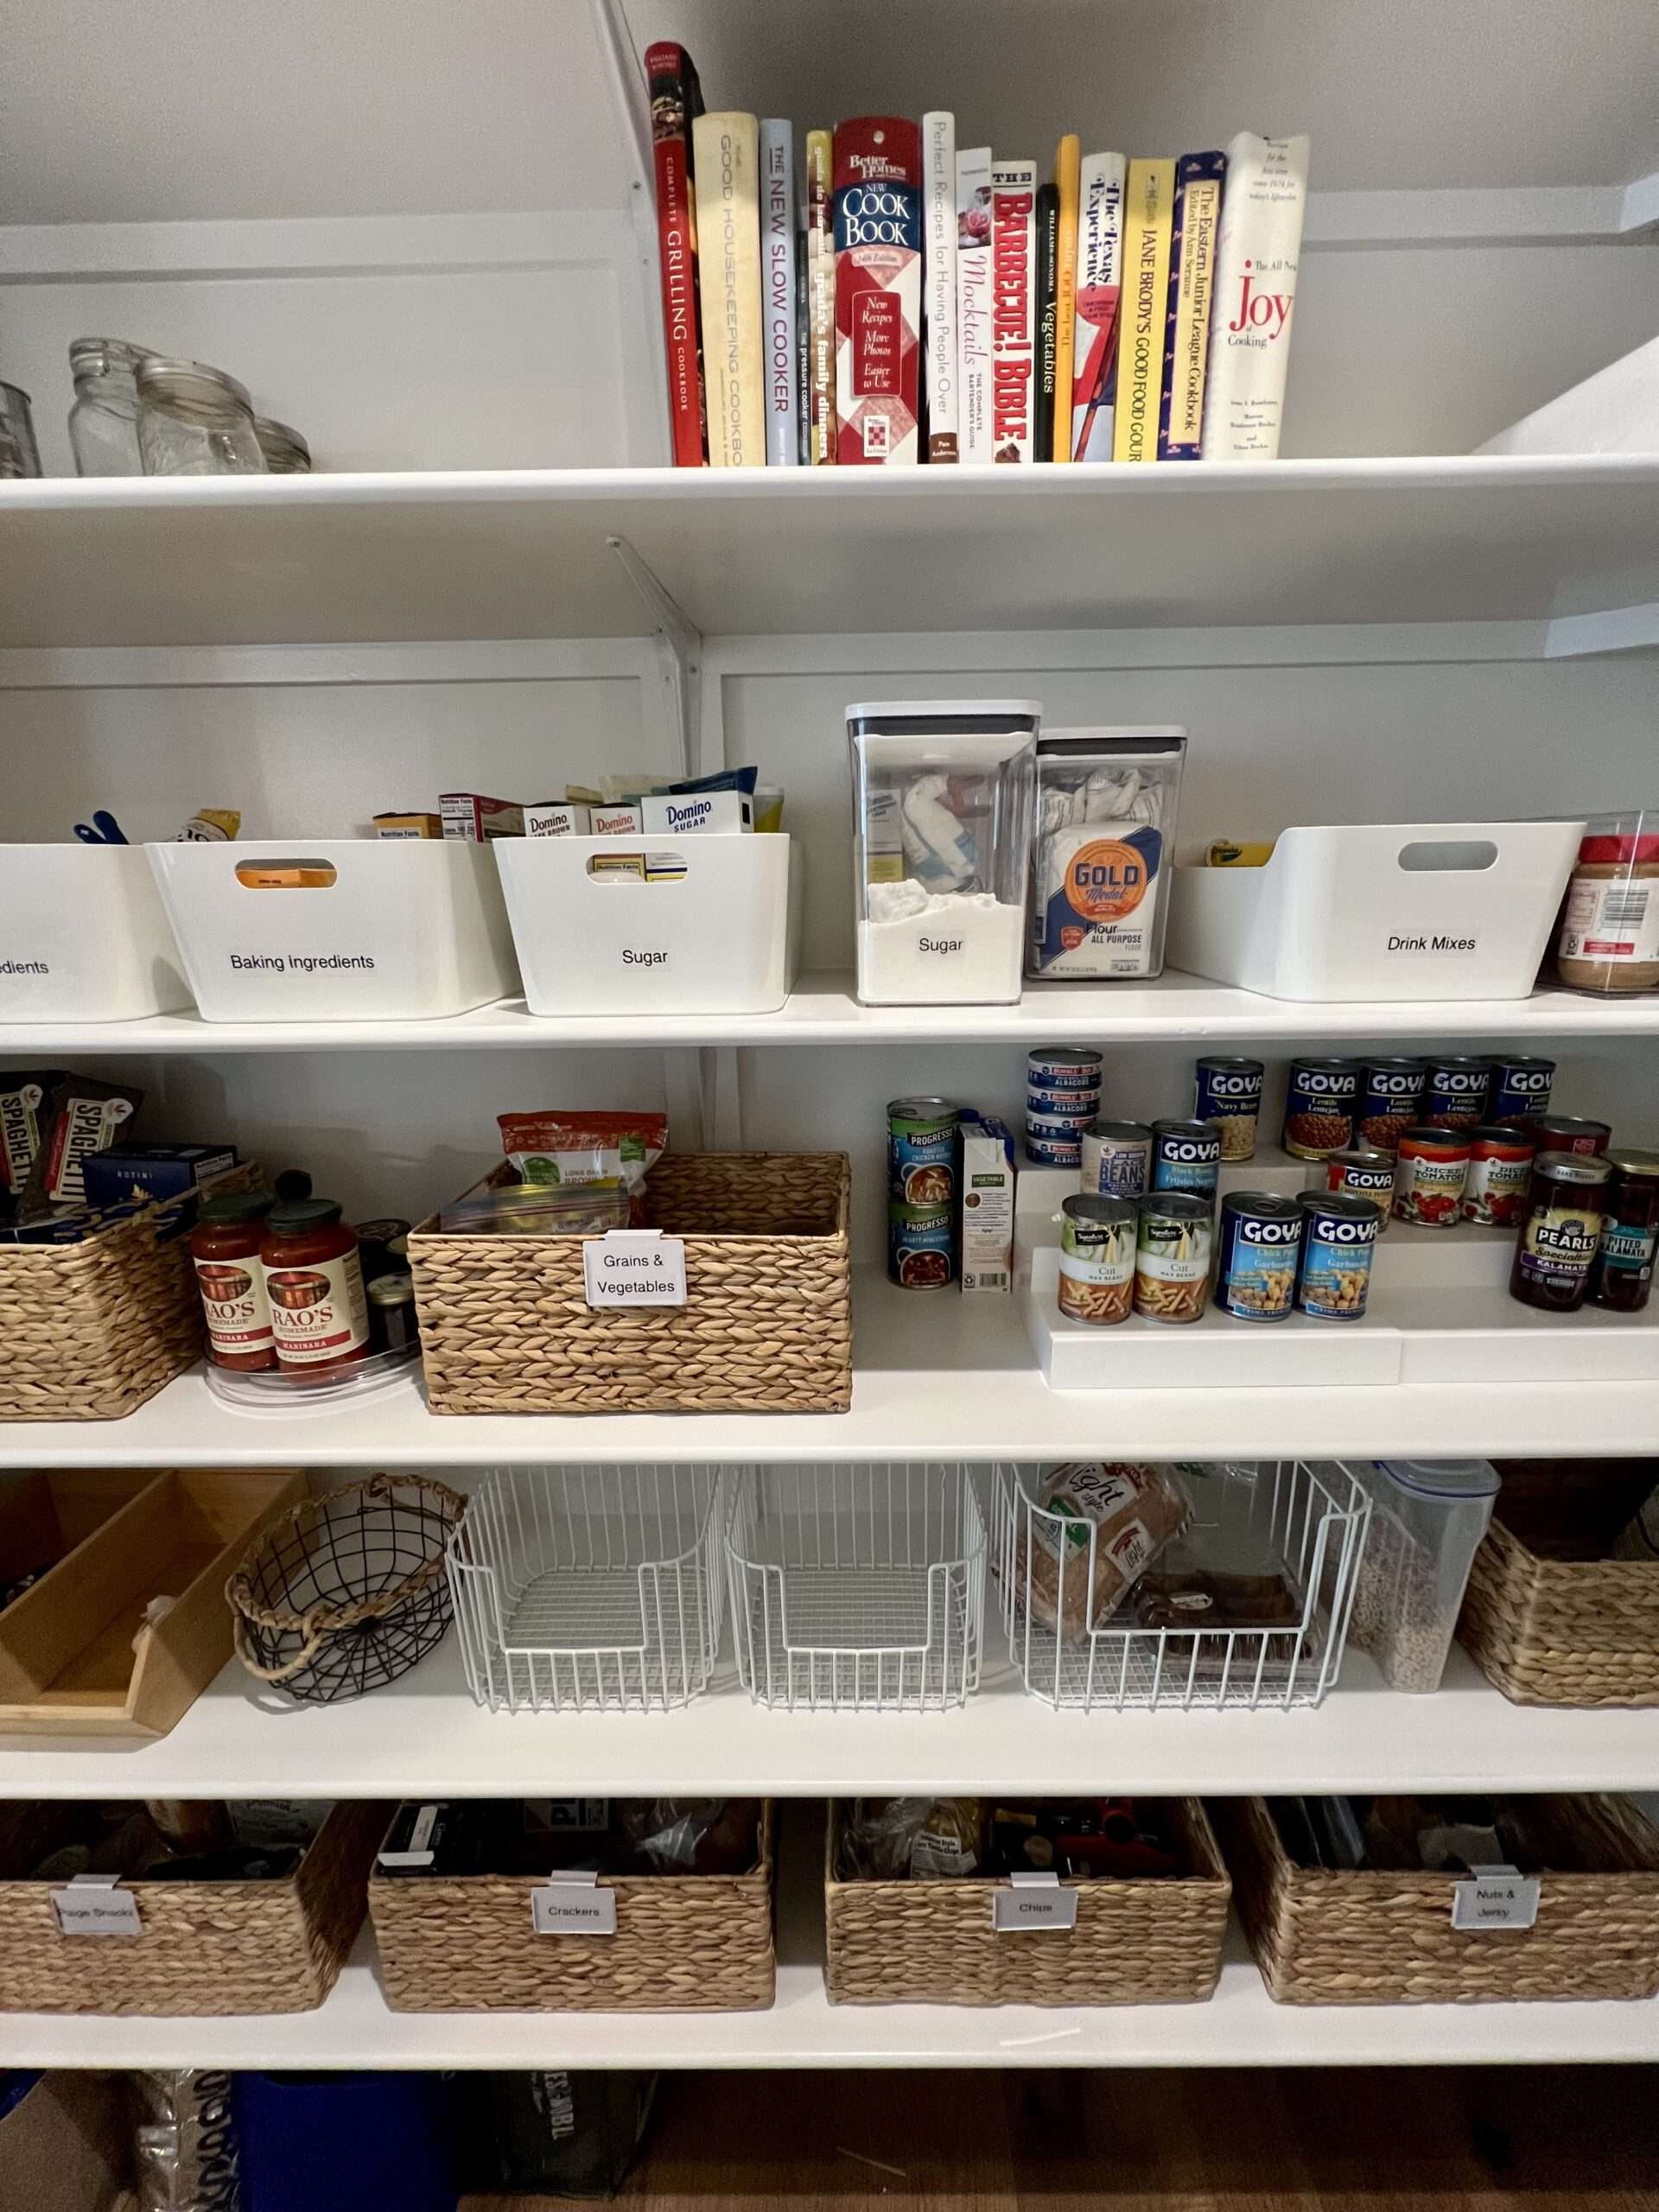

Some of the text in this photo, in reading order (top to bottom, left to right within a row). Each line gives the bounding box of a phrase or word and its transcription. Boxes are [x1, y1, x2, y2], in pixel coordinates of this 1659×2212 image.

[721, 135, 734, 201] GOOD
[775, 145, 785, 174] THE
[849, 155, 889, 168] Better
[862, 164, 907, 179] Homes
[993, 173, 1032, 183] THE
[866, 183, 888, 193] NEW
[771, 180, 786, 237] NEW
[1189, 190, 1199, 222] Edited
[1086, 173, 1106, 292] Experience
[1186, 224, 1198, 236] by
[1141, 230, 1158, 268] JANE
[933, 122, 951, 415] Perfect Recipes for Having People Over
[1255, 260, 1268, 270] The
[1271, 260, 1282, 270] All
[666, 157, 688, 410] COMPLETE GRILLING COOKBOOK
[772, 245, 788, 311] SLOW
[723, 209, 740, 373] HOUSEKEEPING
[866, 296, 888, 310] New
[962, 255, 988, 365] Mocktails
[1136, 271, 1155, 334] BRODY'S
[1185, 187, 1216, 430] The Eastern Junior League Cookbook
[862, 311, 893, 325] Recipes
[994, 192, 1033, 441] BARBECUE! BIBLE
[865, 330, 890, 343] More
[1228, 334, 1268, 350] Cooking
[863, 343, 891, 356] Photos
[1041, 302, 1058, 393] Vegetables
[772, 320, 789, 412] COOKER
[1134, 337, 1150, 378] GOOD
[799, 347, 808, 389] pressure
[864, 363, 891, 377] Easier
[864, 376, 891, 389] to Use
[816, 340, 830, 459] family dinners
[1131, 381, 1147, 420] FOOD
[1128, 422, 1145, 461] GOUR
[666, 800, 712, 826] Domino
[529, 814, 568, 834] Domino
[596, 815, 633, 833] Domino
[673, 816, 706, 834] SUGAR
[1075, 862, 1141, 887] GOLD
[1085, 887, 1127, 904] Medal
[1086, 923, 1118, 935] Flour
[918, 938, 965, 956] Sugar
[1091, 934, 1105, 944] ALL
[1107, 934, 1142, 944] PURPOSE
[1387, 935, 1477, 950] Drink Mixes
[230, 955, 376, 973] Baking Ingredients
[622, 949, 669, 967] Sugar
[1211, 1076, 1263, 1095] GOYA
[1297, 1072, 1356, 1093] GOYA
[1372, 1074, 1425, 1093] GOYA
[1433, 1072, 1490, 1091] GOYA
[1217, 1099, 1238, 1111] Navy
[1164, 1141, 1220, 1160] GOYA
[118, 1171, 154, 1180] ROTINI
[1100, 1166, 1145, 1183] BEANS
[1347, 1173, 1393, 1187] GOYA
[906, 1216, 950, 1232] PROGRESSO
[1244, 1221, 1302, 1243] GOYA
[1318, 1220, 1378, 1242] GOYA
[1538, 1229, 1597, 1249] PEARLS
[603, 1254, 664, 1268] Grains &
[1170, 1263, 1188, 1272] Cut
[1536, 1259, 1588, 1271] KALAMATA
[1098, 1267, 1116, 1275] Cut
[597, 1281, 676, 1296] Vegetables
[272, 1306, 333, 1326] RAO'S
[278, 1324, 327, 1334] HOMEMADE
[282, 1340, 327, 1350] MARINARA
[1082, 1492, 1105, 1513] style
[1476, 1890, 1516, 1899] Nuts &
[548, 1905, 601, 1916] Crackers
[1019, 1902, 1053, 1913] Chips
[1478, 1908, 1510, 1918] Jerky
